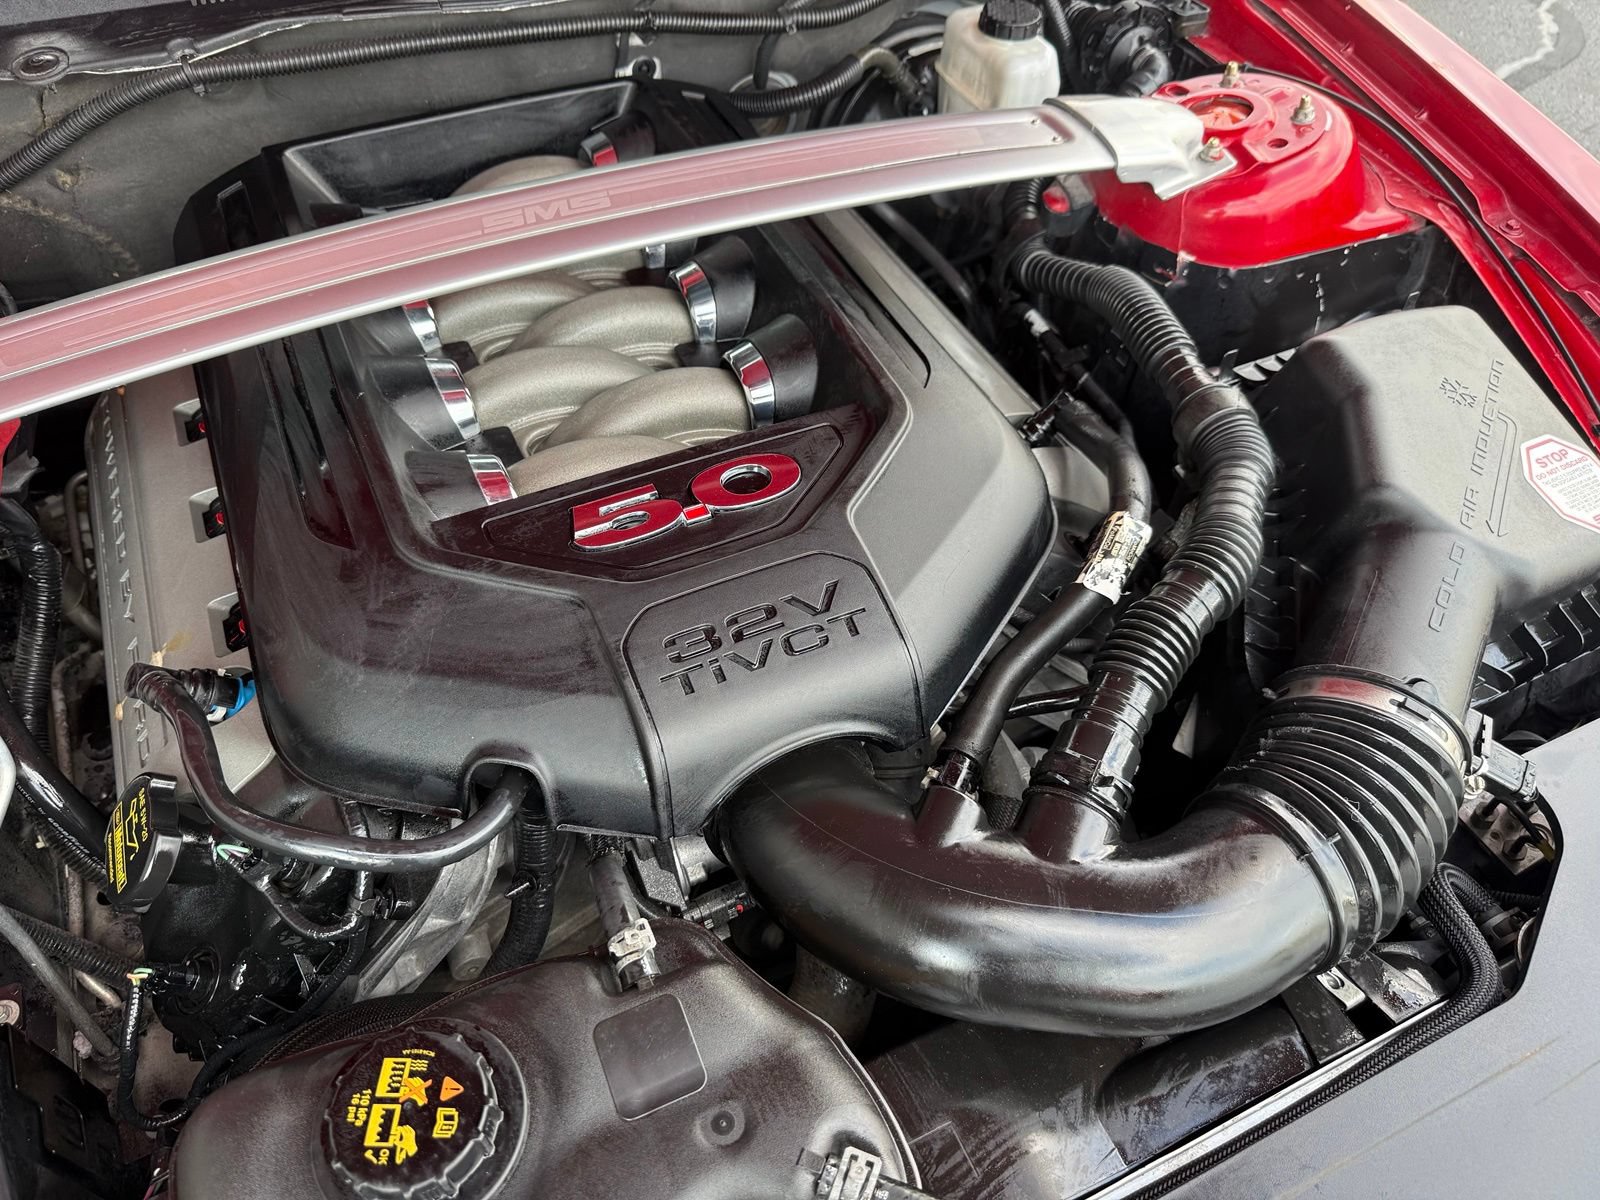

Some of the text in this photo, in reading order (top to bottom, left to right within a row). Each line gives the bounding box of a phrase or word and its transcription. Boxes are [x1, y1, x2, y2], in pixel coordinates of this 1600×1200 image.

[1535, 448, 1569, 469] STOP
[1535, 472, 1547, 481] DO
[1546, 466, 1561, 476] NOT
[1560, 456, 1589, 471] DISCARD
[573, 453, 802, 550] 5.0
[1428, 358, 1505, 633] COLD AIR INDUCTION
[120, 569, 135, 623] BY
[662, 579, 840, 664] 32V
[659, 607, 866, 696] TiVCT
[127, 636, 150, 768] FRD
[138, 787, 149, 842] SAE 5W-20
[346, 1106, 357, 1123] psi
[354, 1088, 372, 1127] 110 kPa
[378, 1148, 390, 1166] OK
